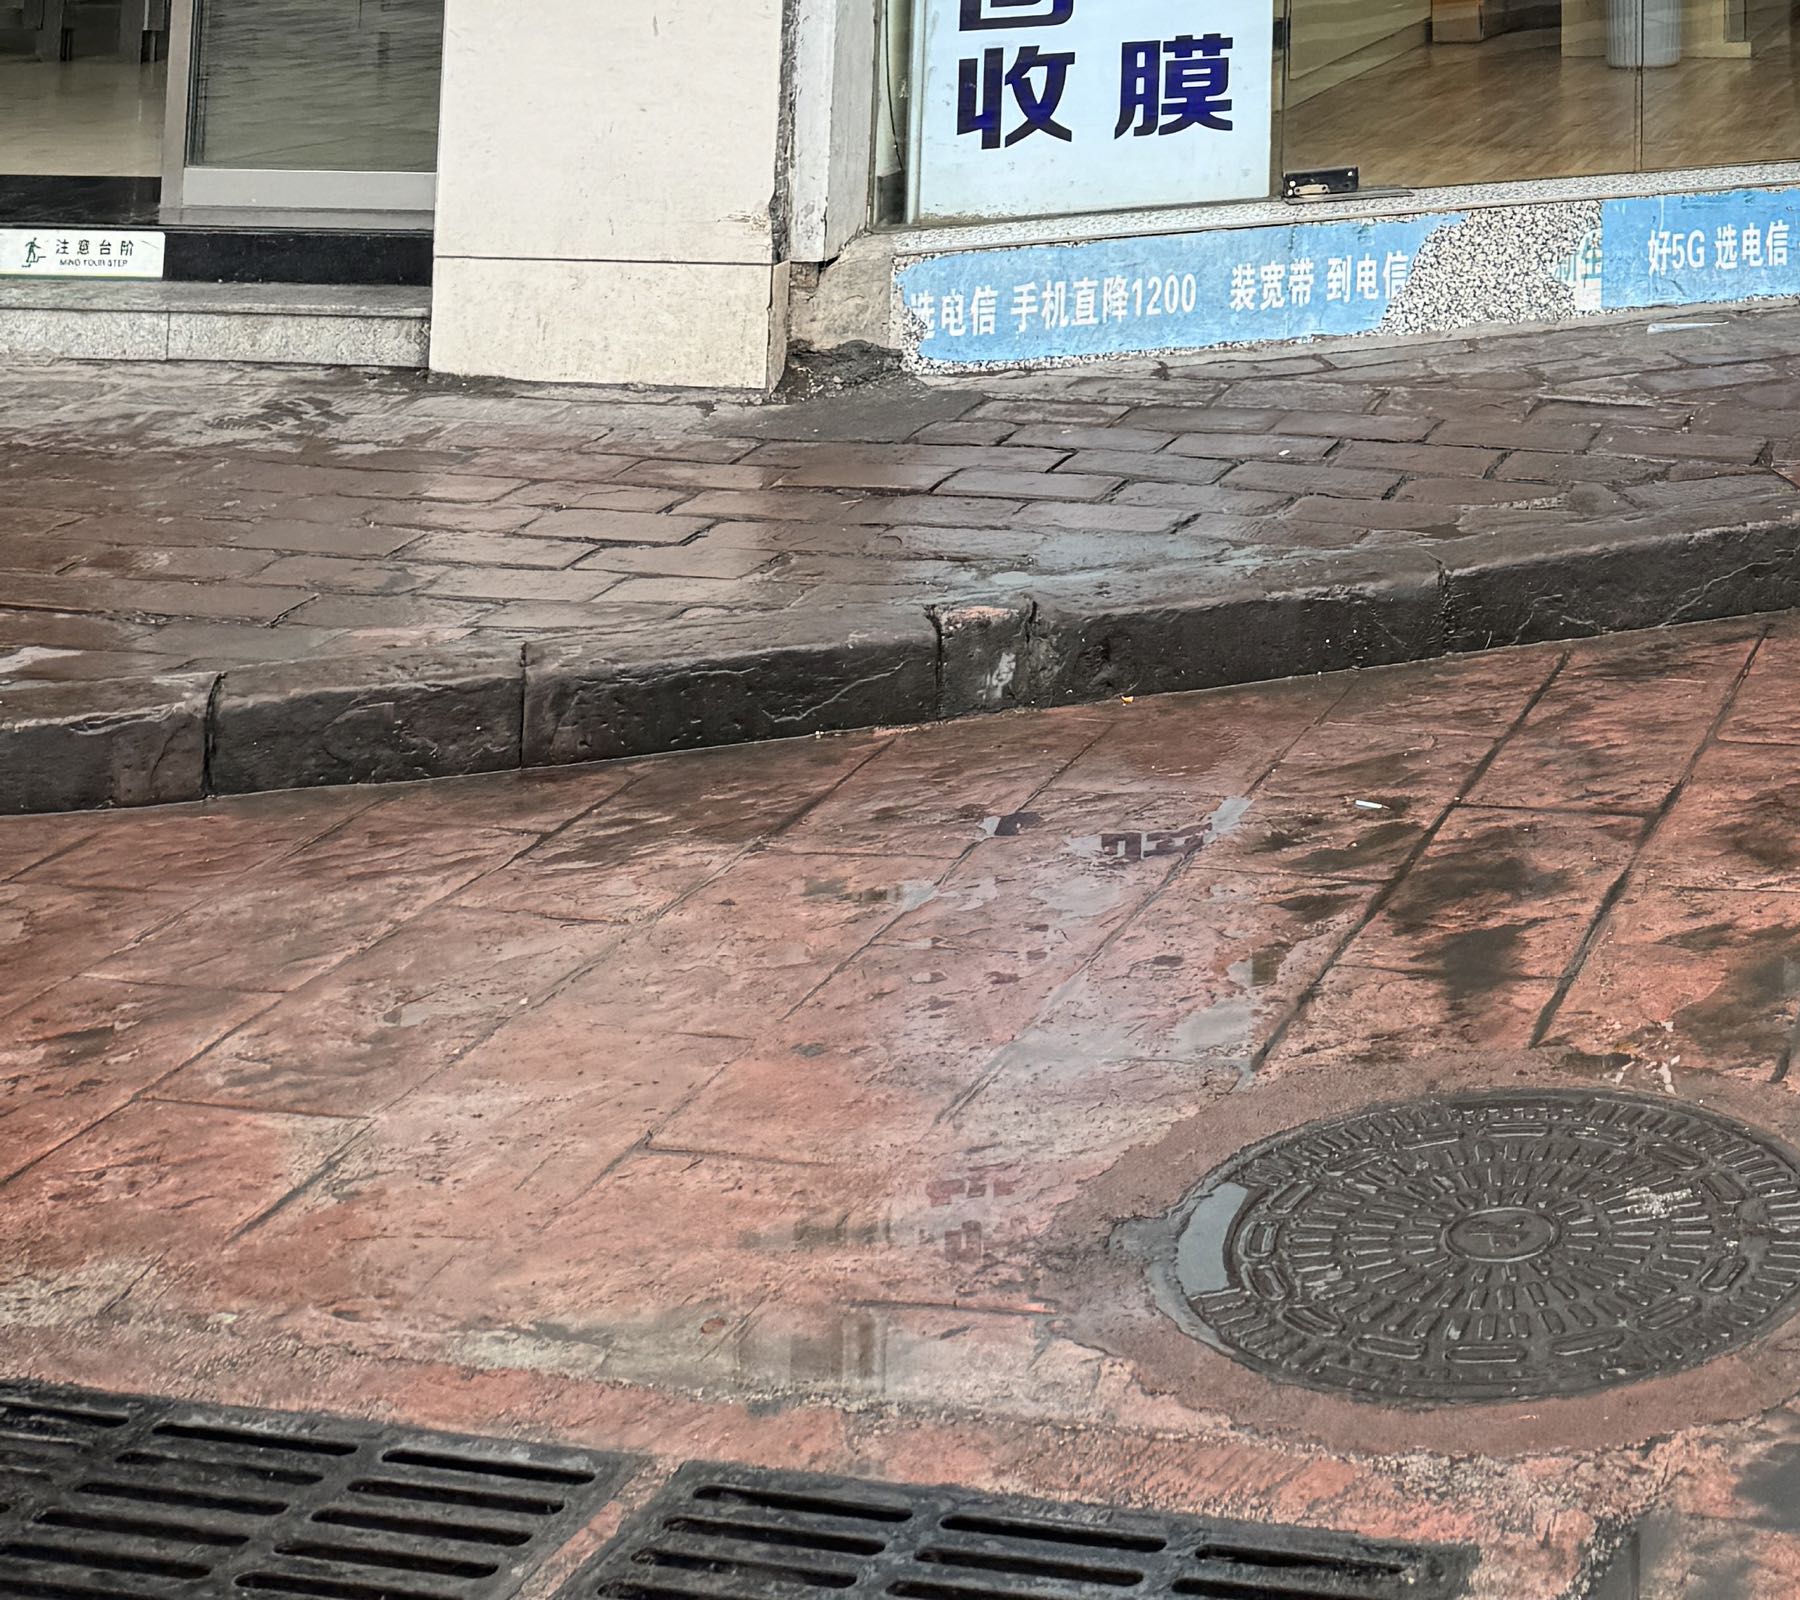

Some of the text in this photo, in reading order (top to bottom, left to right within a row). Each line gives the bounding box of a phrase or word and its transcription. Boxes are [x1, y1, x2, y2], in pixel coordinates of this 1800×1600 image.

[56, 238, 134, 256] 注意台阶
[1647, 229, 1705, 276] 好5G
[1714, 218, 1791, 270] 选电信
[1010, 273, 1197, 333] 手机直降1200
[1229, 257, 1315, 313] 装宽带
[1326, 250, 1409, 304] 到电信
